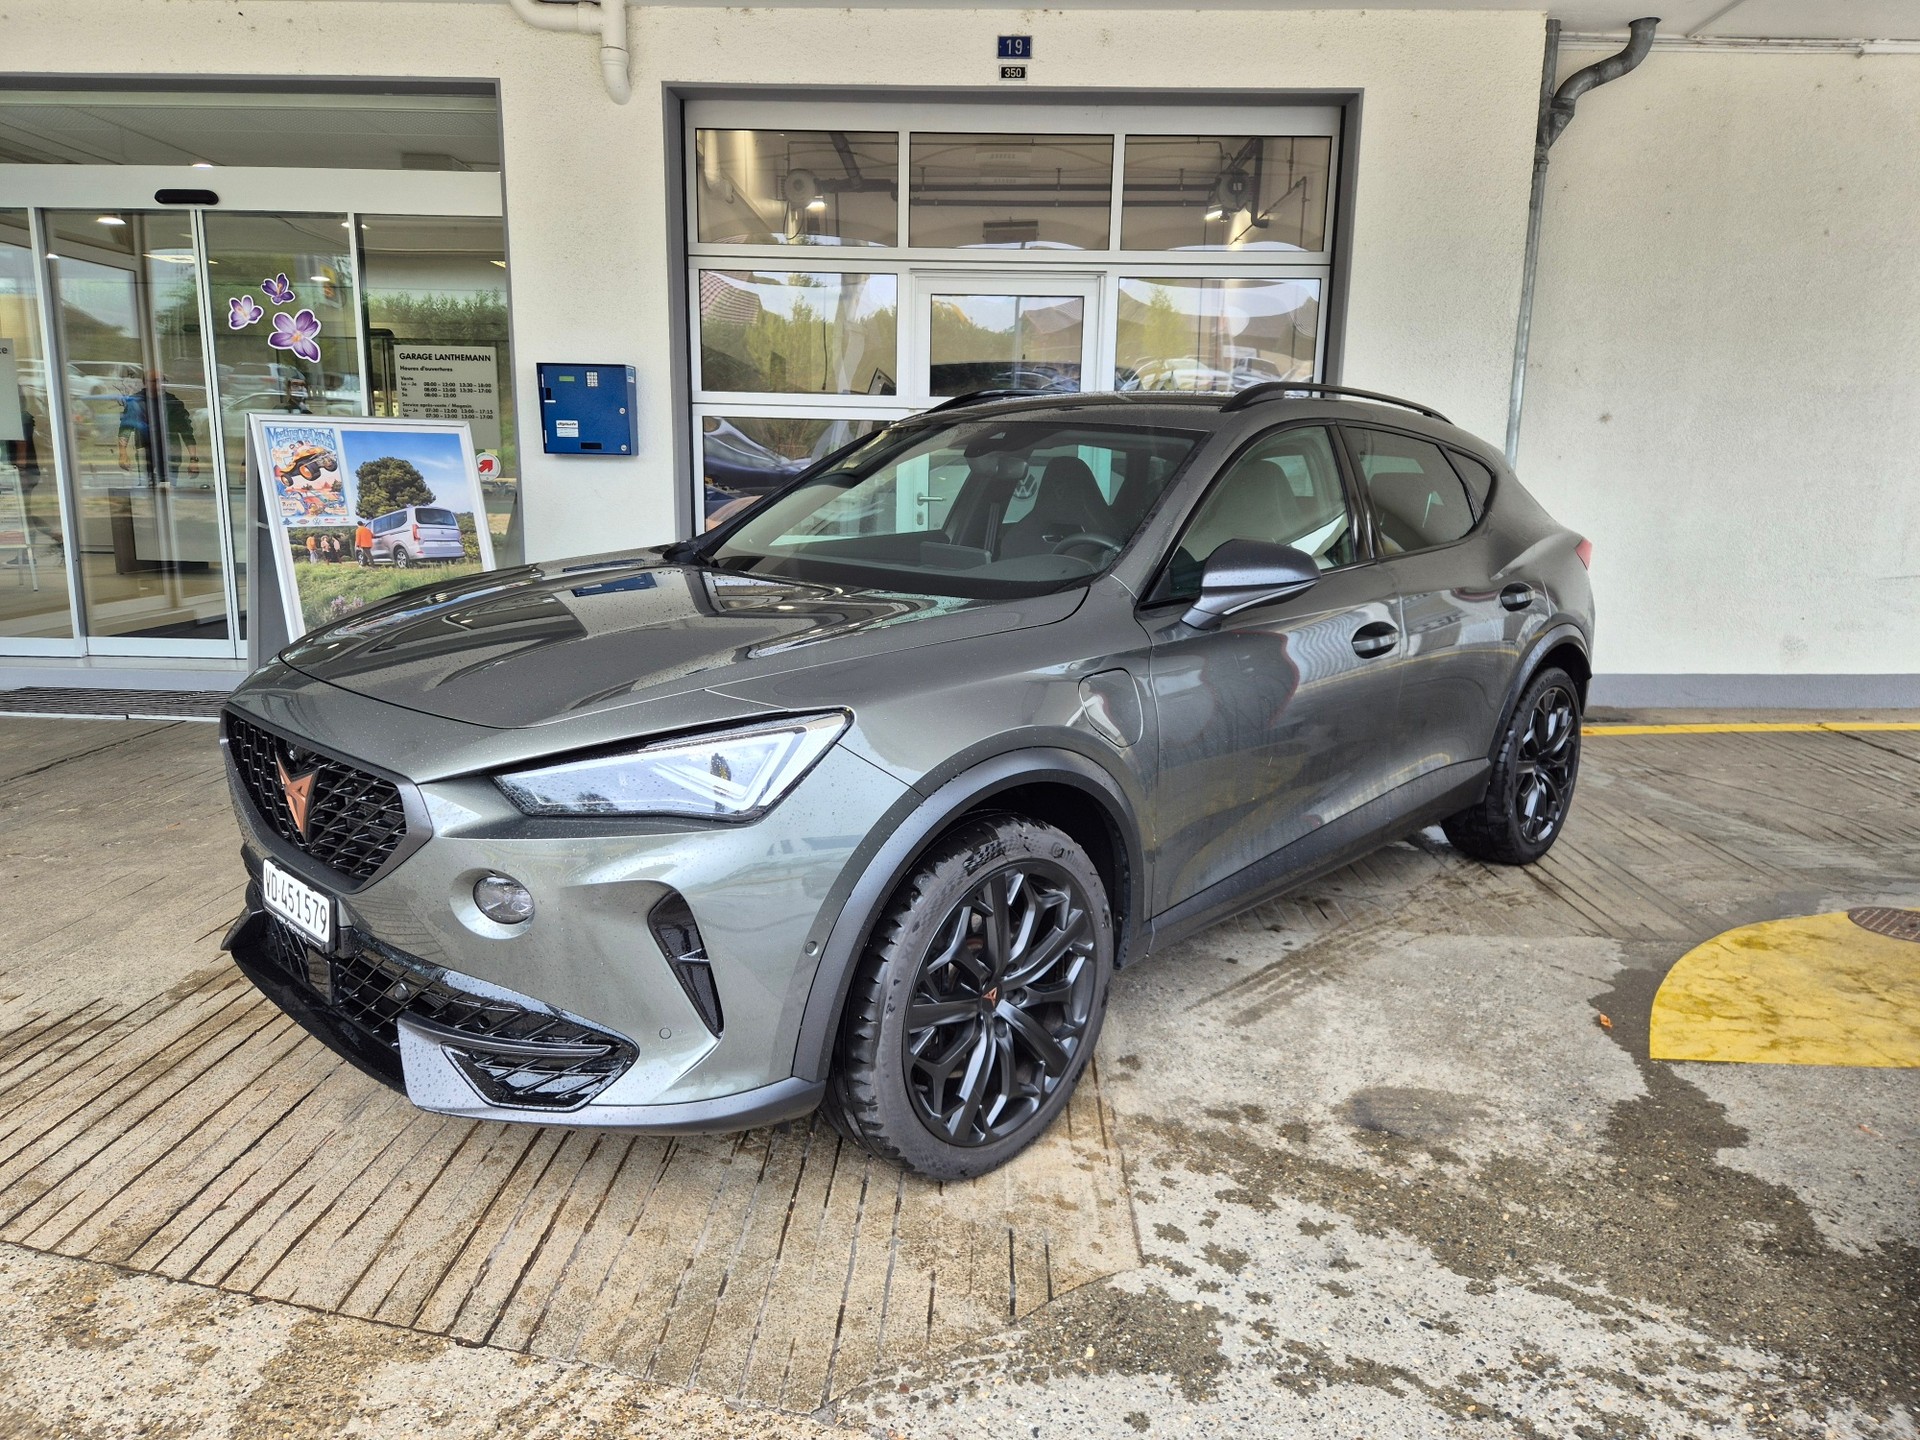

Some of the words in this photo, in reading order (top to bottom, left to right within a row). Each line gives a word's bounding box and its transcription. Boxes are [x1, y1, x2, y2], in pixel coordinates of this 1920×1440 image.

[1006, 39, 1023, 55] 19
[1004, 67, 1022, 78] 350
[399, 352, 433, 361] GARAGE
[434, 353, 491, 362] LANTHEMANN
